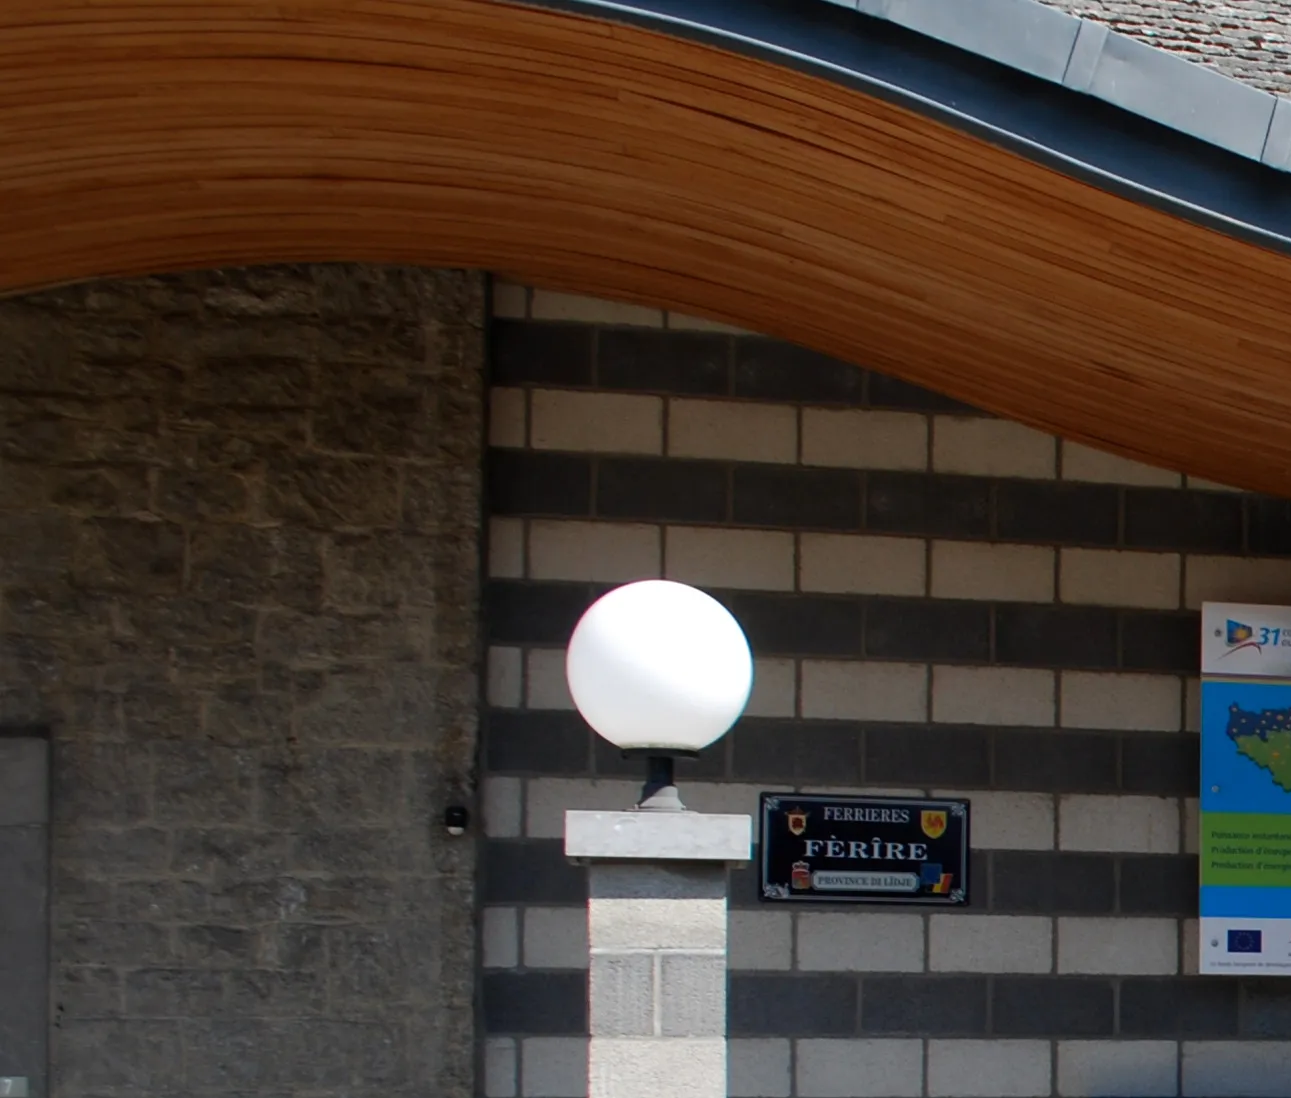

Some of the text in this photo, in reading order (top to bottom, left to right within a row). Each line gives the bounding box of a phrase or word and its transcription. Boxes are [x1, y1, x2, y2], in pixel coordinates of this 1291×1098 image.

[1258, 627, 1281, 646] 31
[823, 806, 910, 823] FERRIERES
[803, 834, 929, 861] FÈRÎRE
[817, 875, 869, 887] PROVINCE
